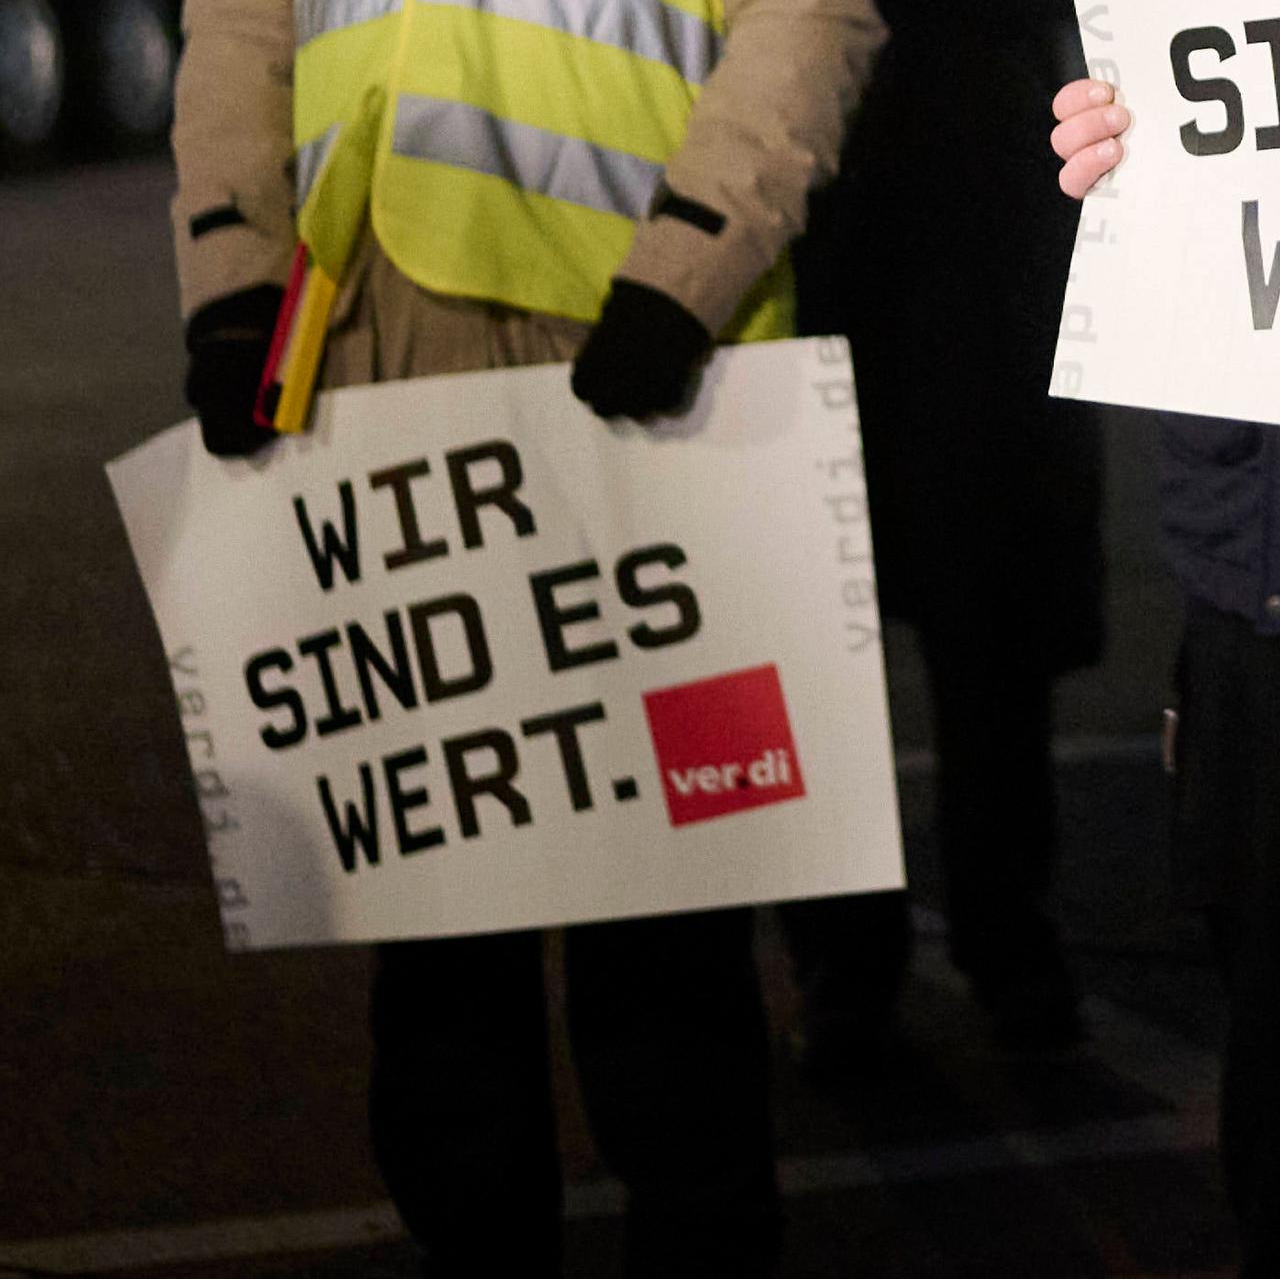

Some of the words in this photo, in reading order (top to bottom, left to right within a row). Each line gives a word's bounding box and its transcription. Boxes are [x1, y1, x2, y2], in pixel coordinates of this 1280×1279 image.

[293, 439, 537, 593] WIR
[244, 593, 494, 751] SIND
[529, 544, 702, 674] ES
[316, 701, 640, 875] WERT.
